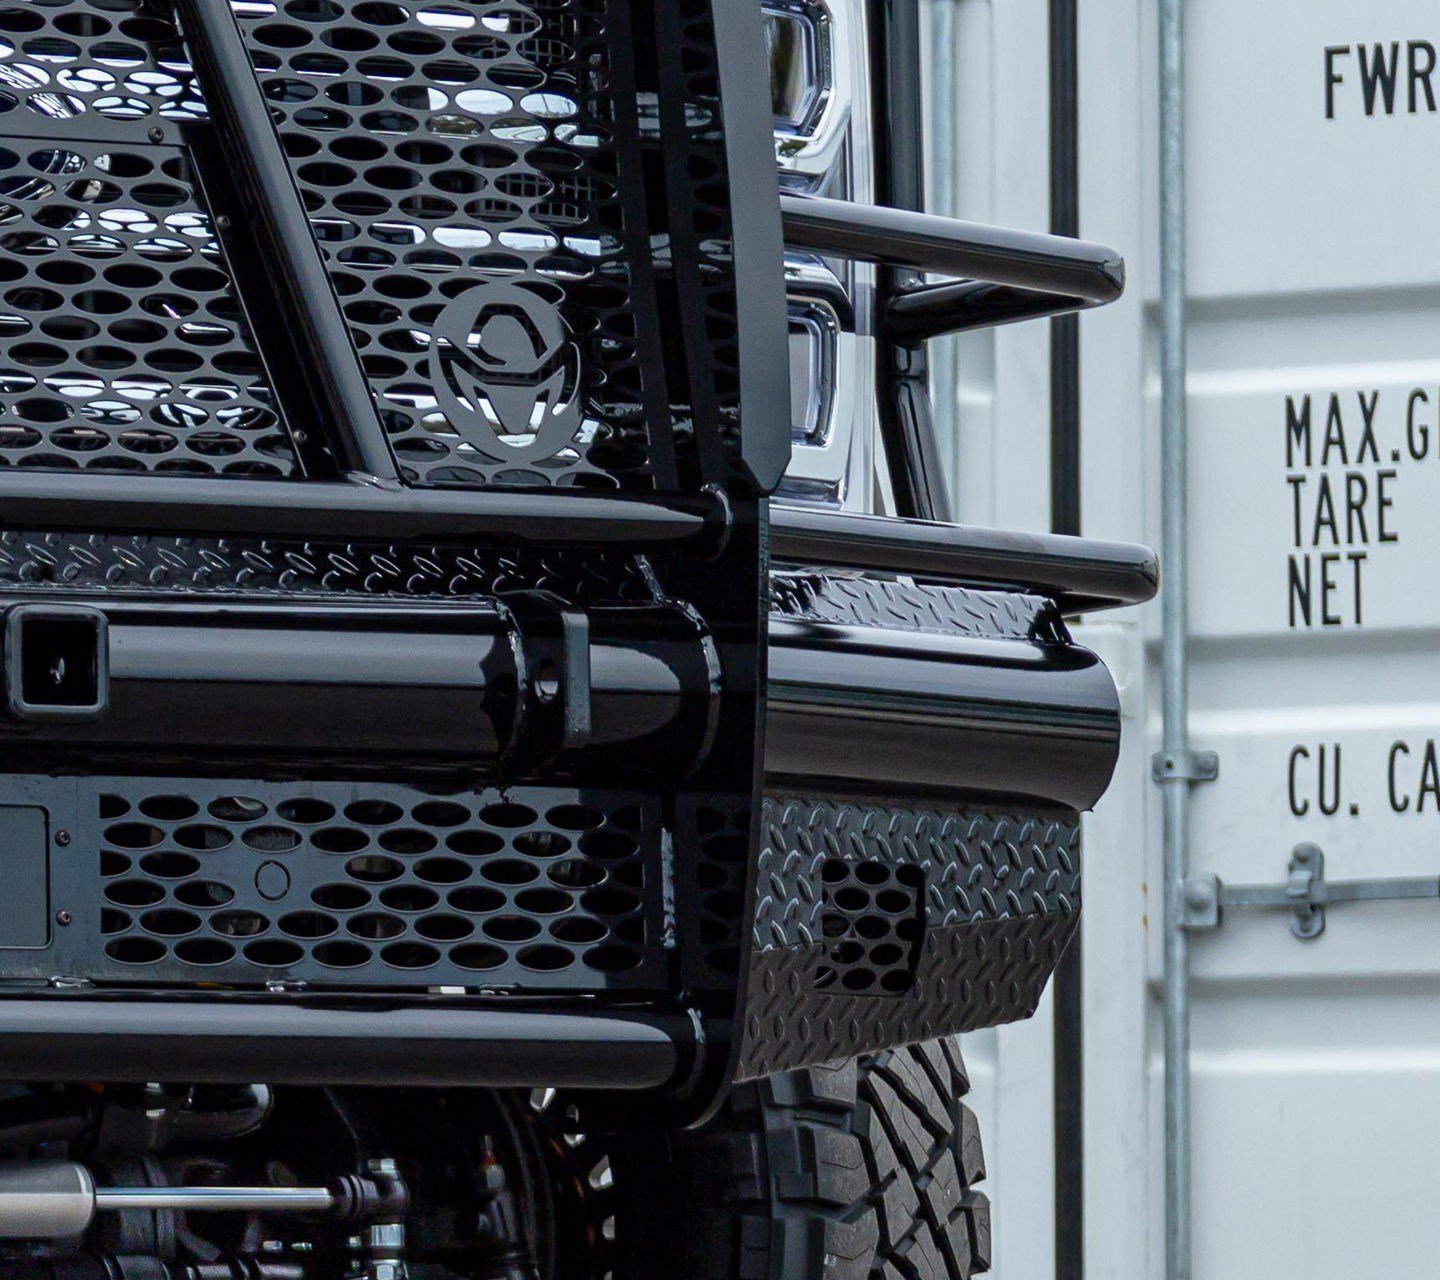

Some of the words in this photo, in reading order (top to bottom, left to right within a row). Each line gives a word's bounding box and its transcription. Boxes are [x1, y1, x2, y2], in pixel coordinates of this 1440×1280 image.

[1324, 39, 1438, 119] FWR
[1286, 387, 1440, 467] MAX.G
[1286, 469, 1398, 547] TARE
[1288, 551, 1367, 627] NET
[1288, 743, 1360, 816] CU.
